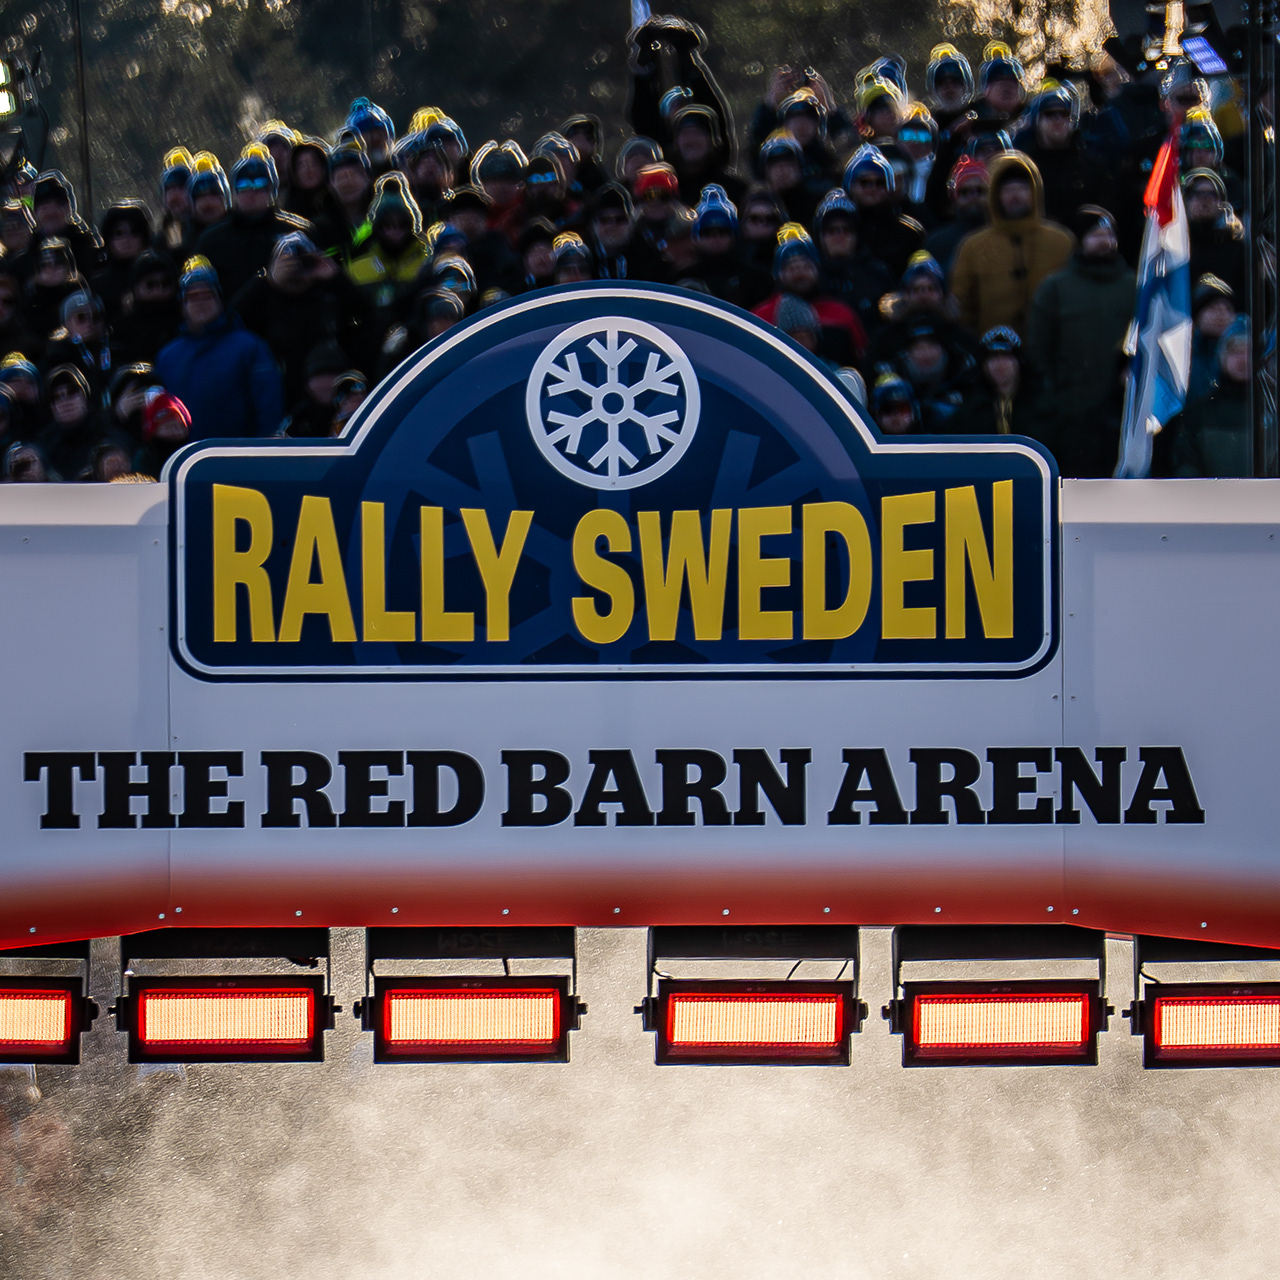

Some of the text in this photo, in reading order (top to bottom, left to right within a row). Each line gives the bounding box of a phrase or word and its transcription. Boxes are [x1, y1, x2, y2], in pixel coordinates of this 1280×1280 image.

[212, 480, 1014, 644] RALLY SWEDEN
[23, 746, 1206, 830] THE RED BARN ARENA
